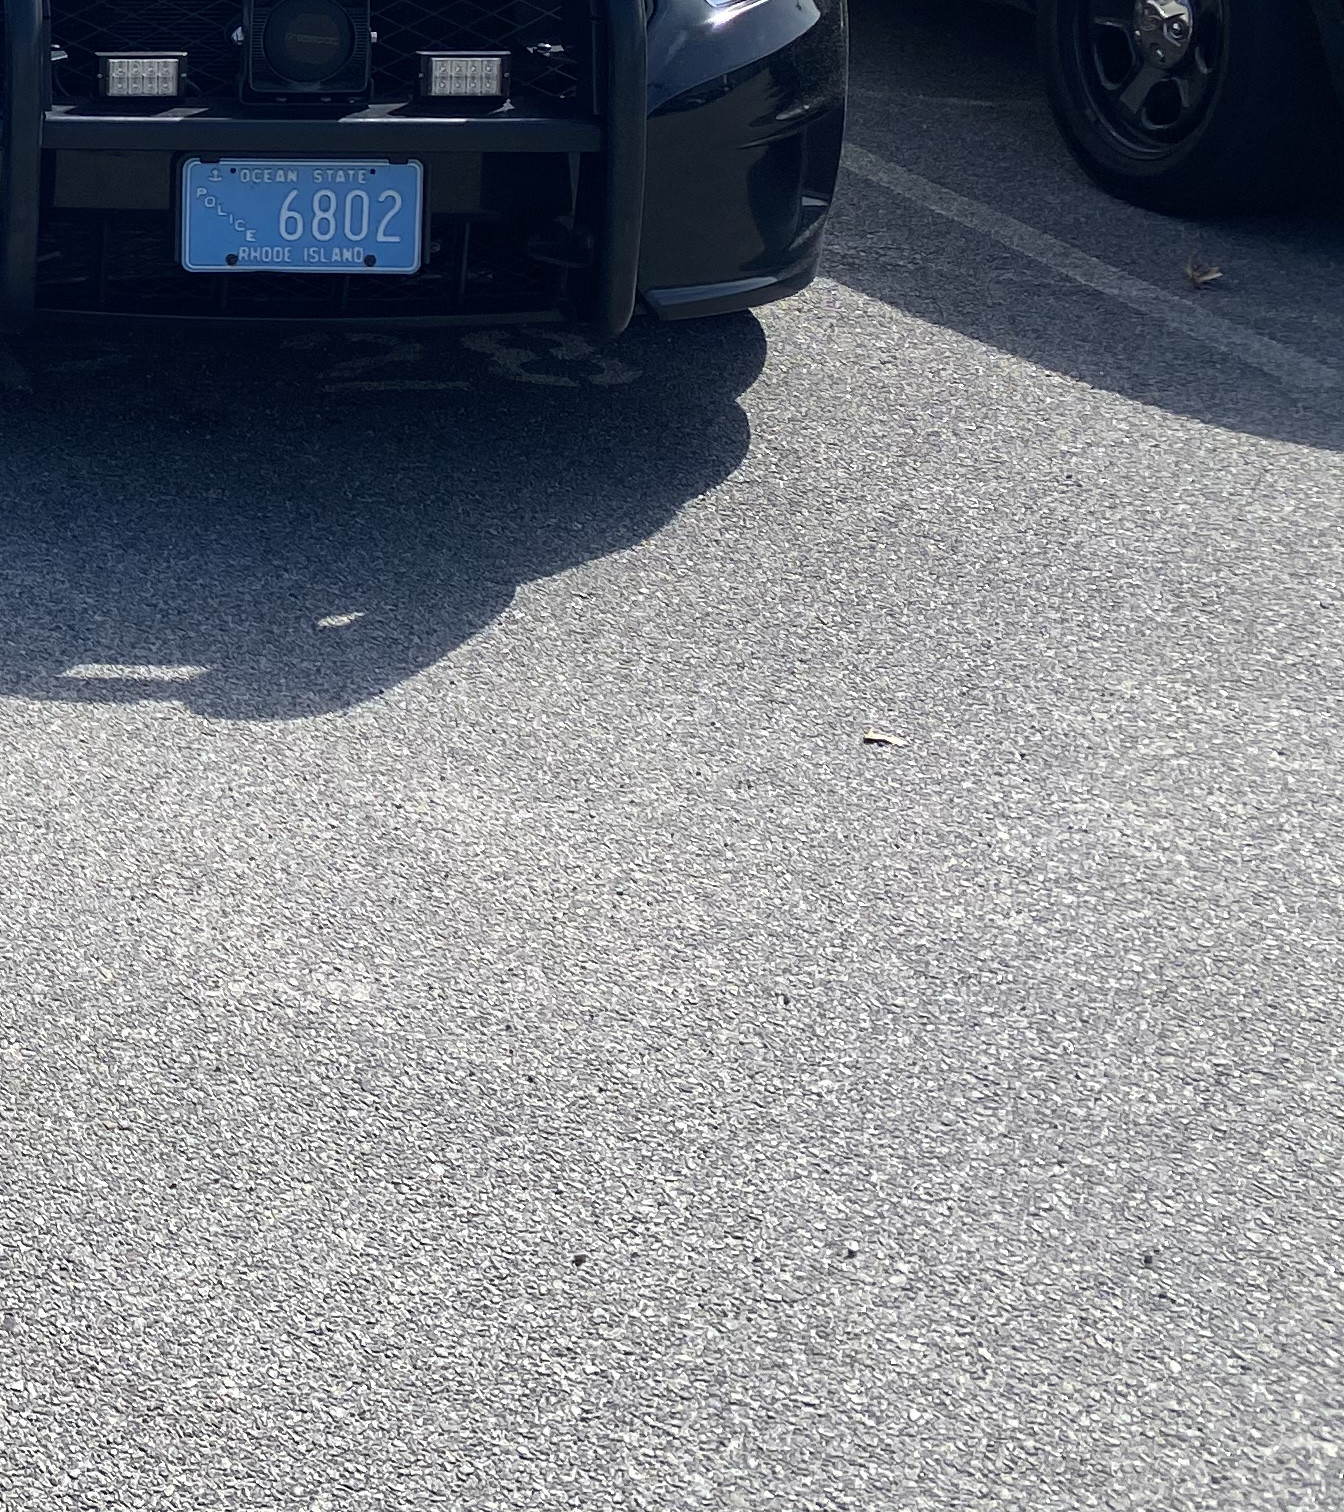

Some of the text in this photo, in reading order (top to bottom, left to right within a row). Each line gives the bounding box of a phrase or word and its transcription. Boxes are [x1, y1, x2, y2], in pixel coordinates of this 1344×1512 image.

[239, 168, 368, 184] OCEAN STATE
[196, 187, 257, 242] POLICE
[278, 188, 403, 243] 6802
[238, 246, 364, 263] RHODE ISLAND
